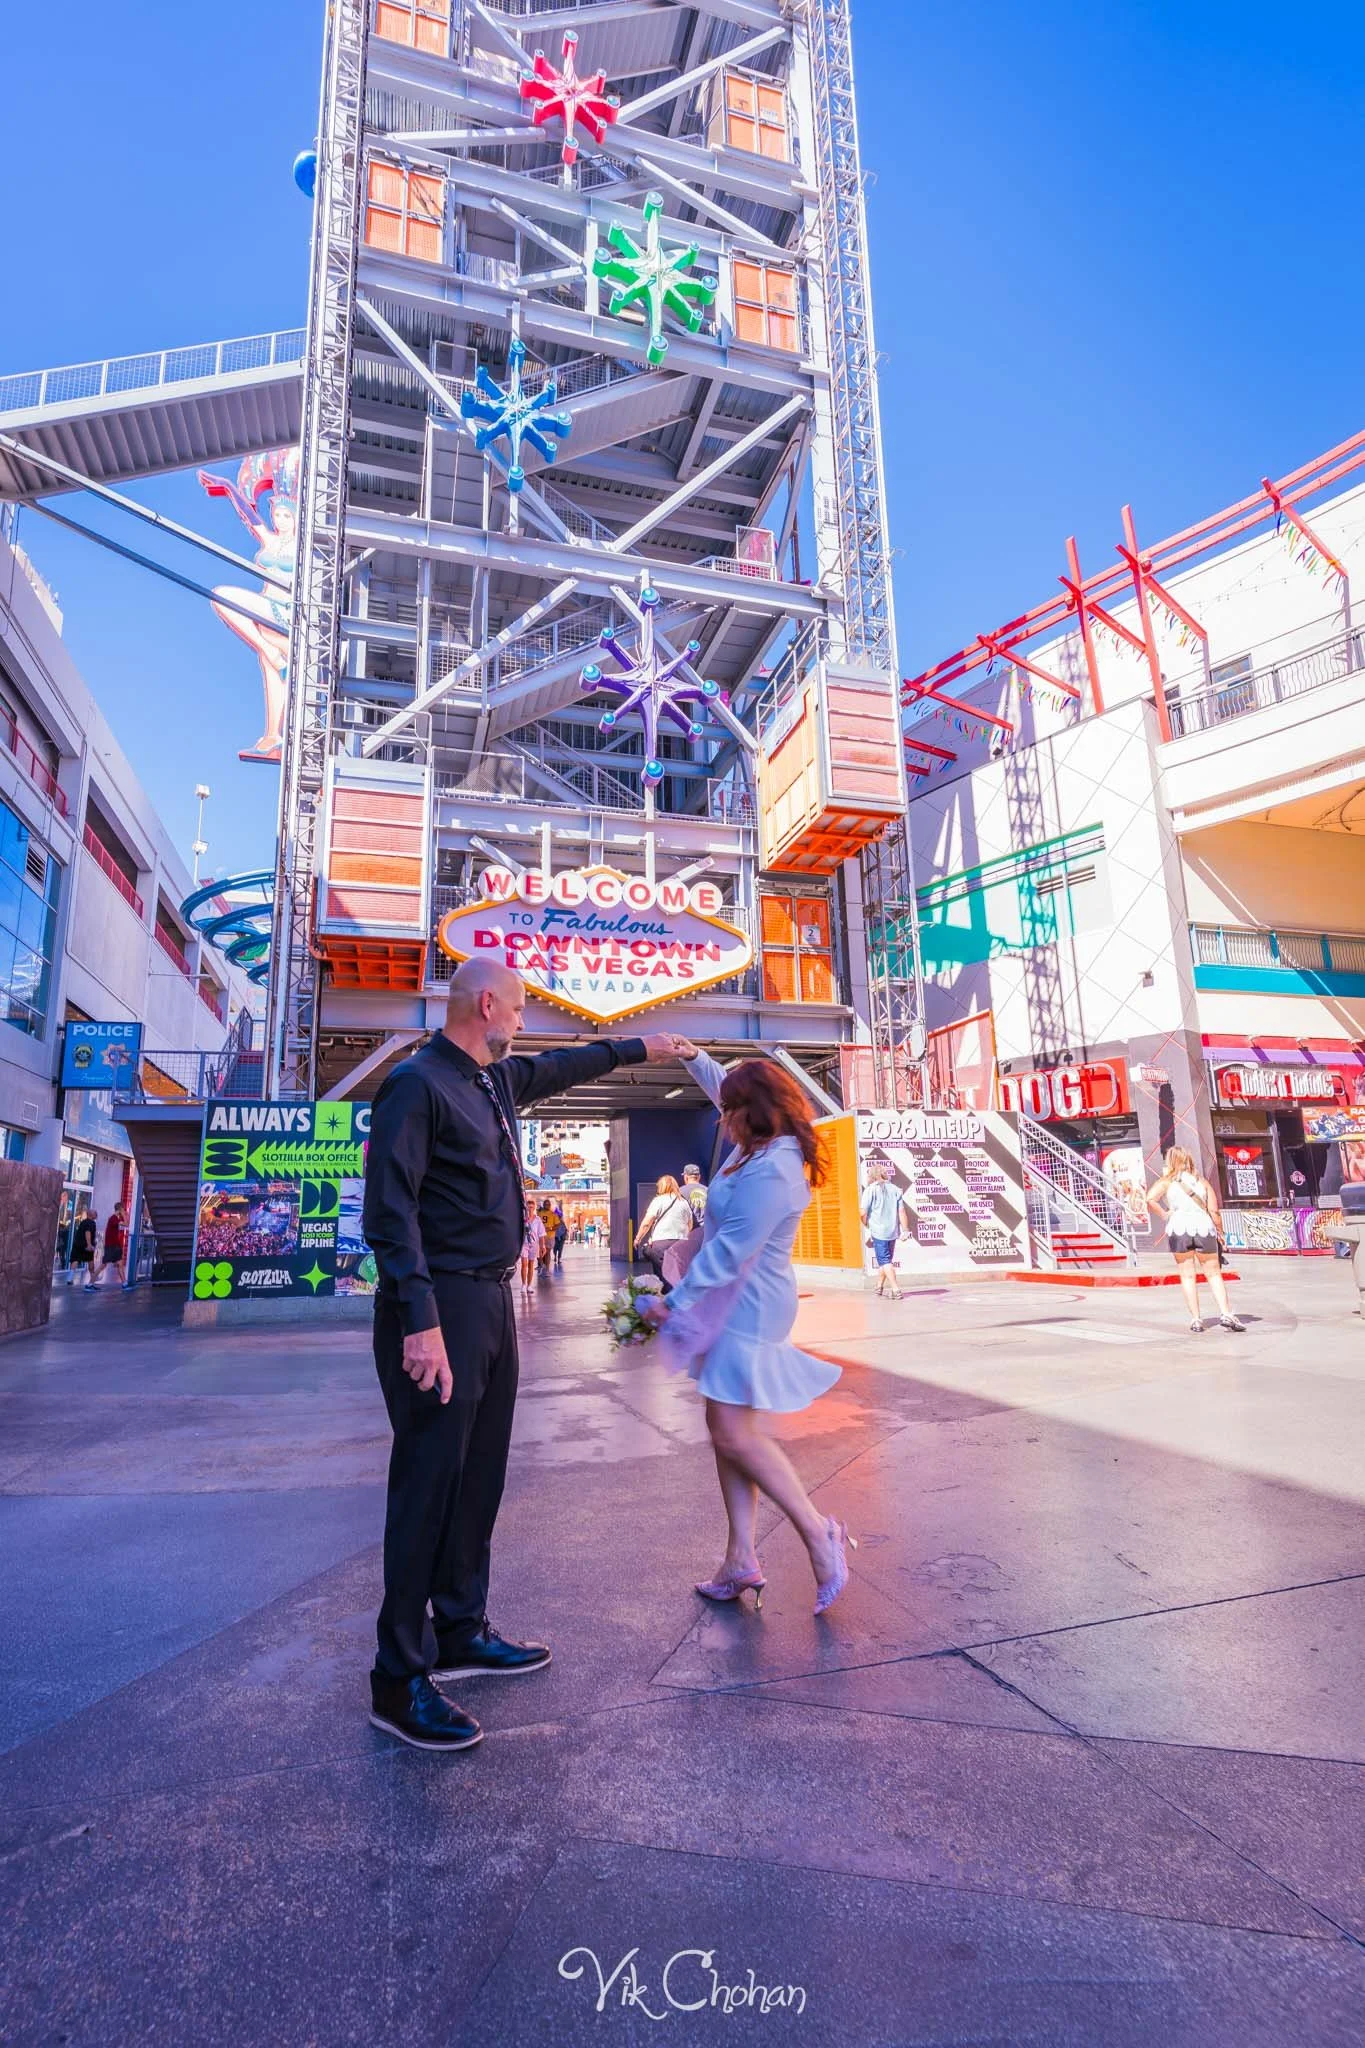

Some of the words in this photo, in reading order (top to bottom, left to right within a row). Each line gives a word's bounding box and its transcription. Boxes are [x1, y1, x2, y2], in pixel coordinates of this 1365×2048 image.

[483, 870, 716, 910] WELCOME
[509, 912, 533, 926] TO
[540, 908, 673, 935] Fabulous
[473, 930, 721, 962] DOWNTOWN
[505, 952, 569, 972] LAS
[583, 956, 695, 978] VEGAS
[552, 976, 653, 994] NEVADA
[72, 1024, 134, 1037] POLICE
[209, 1106, 311, 1132] ALWAYS
[862, 1119, 918, 1140] 2026
[262, 1153, 303, 1162] SLOTZILLA
[306, 1153, 325, 1162] BOX
[328, 1153, 358, 1162] OFFICE
[972, 1237, 1010, 1249] SUMMER
[237, 1268, 293, 1286] SLOTZILLA
